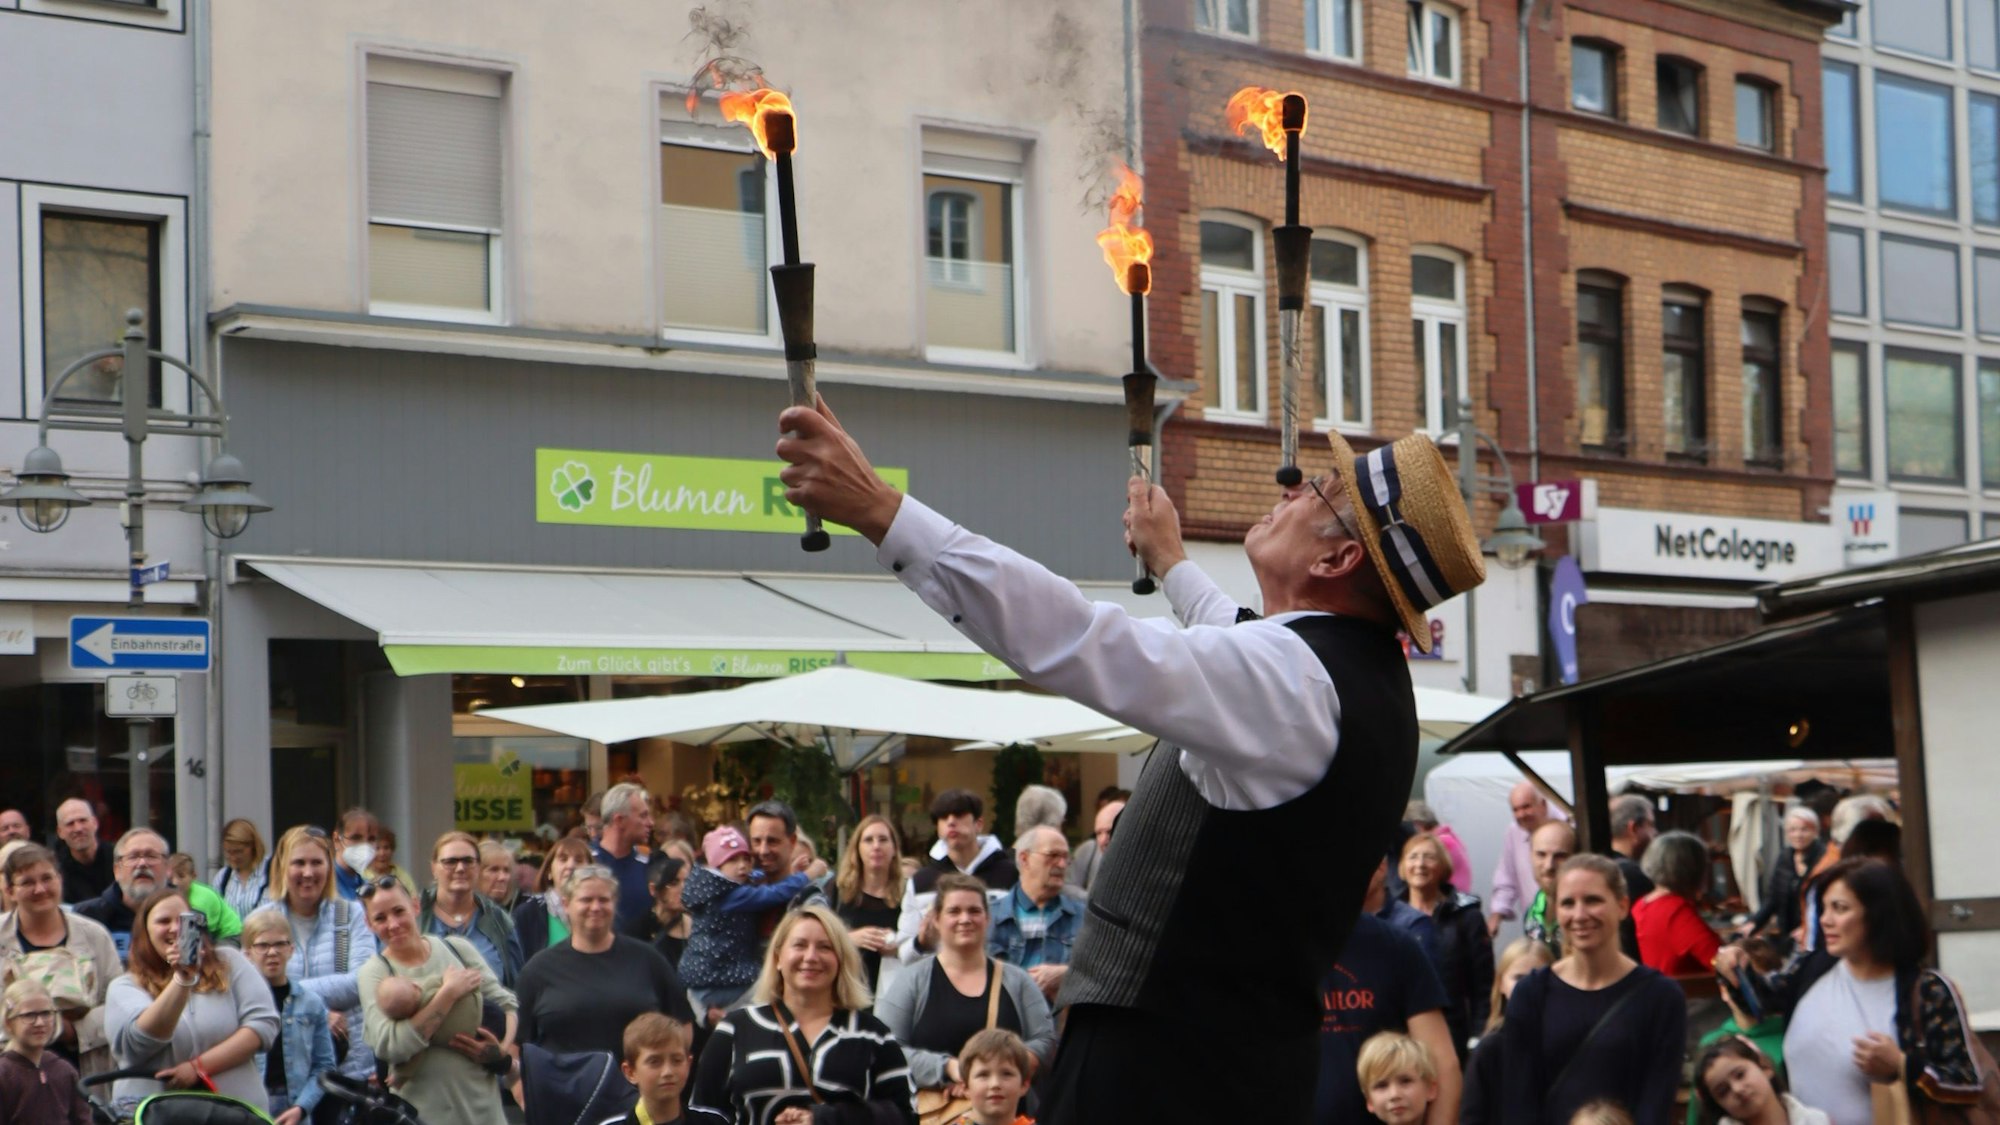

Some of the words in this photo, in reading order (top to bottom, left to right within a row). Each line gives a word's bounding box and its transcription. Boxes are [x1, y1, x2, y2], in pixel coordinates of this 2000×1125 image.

[609, 463, 754, 515] Blumen
[1655, 524, 1795, 571] NetCologne
[111, 638, 202, 651] Einbahnstraße
[557, 656, 591, 671] Zum
[598, 656, 641, 672] Glück
[732, 656, 783, 673] Blumen
[789, 657, 836, 673] RISS
[185, 758, 206, 779] 16
[456, 771, 520, 797] lumen
